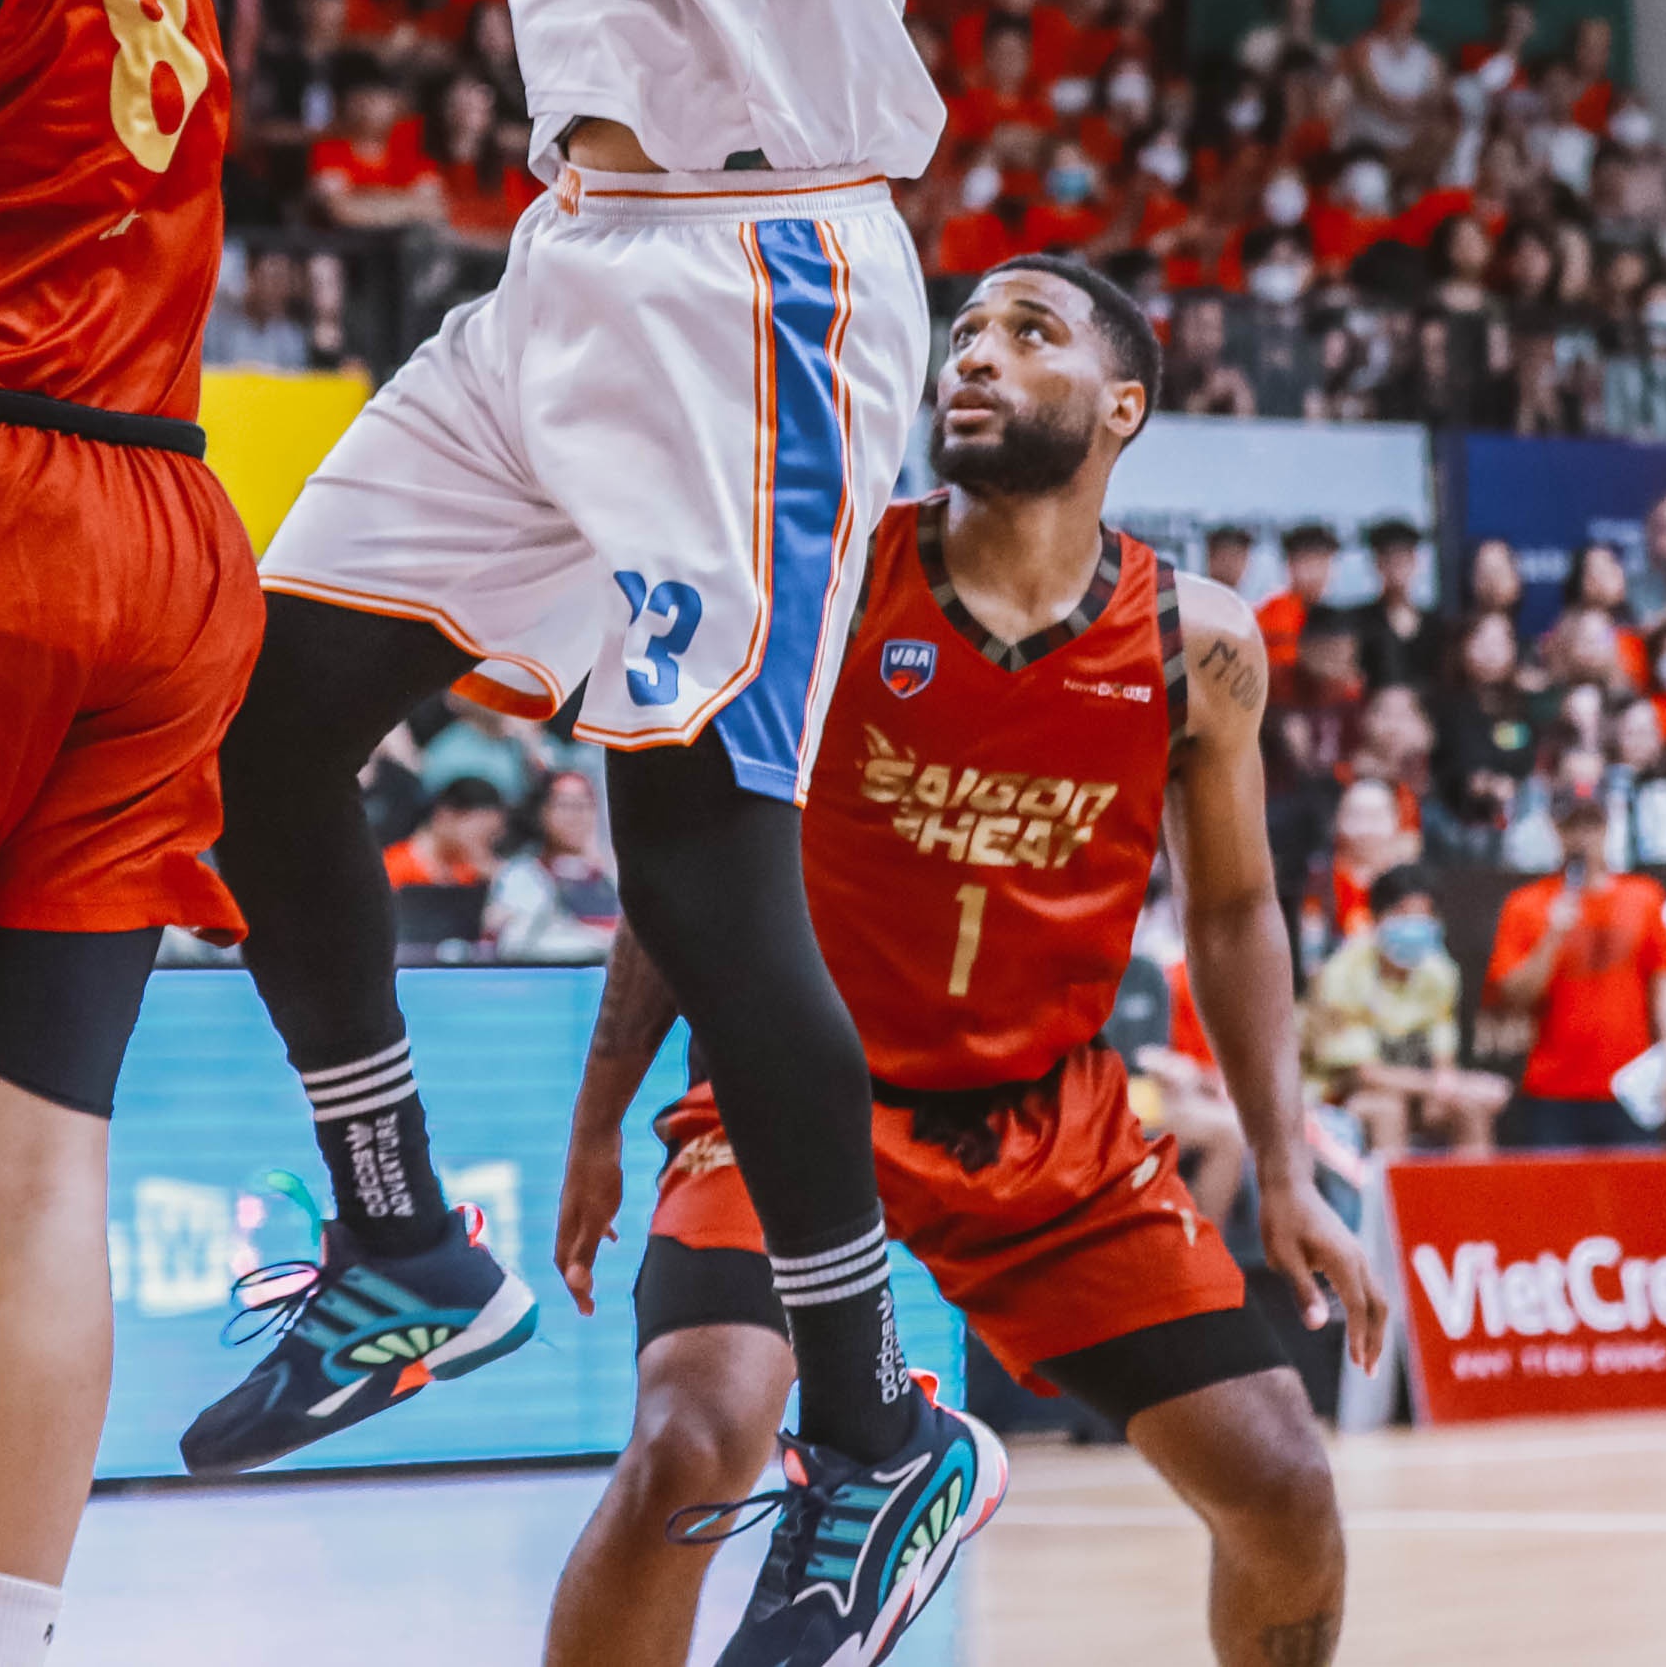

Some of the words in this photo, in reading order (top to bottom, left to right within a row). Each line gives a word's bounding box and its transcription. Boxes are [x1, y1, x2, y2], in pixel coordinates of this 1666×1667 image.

[890, 647, 930, 668] VBA
[859, 756, 1120, 827] SAIGON
[947, 883, 988, 997] 1
[874, 1318, 900, 1405] adidas
